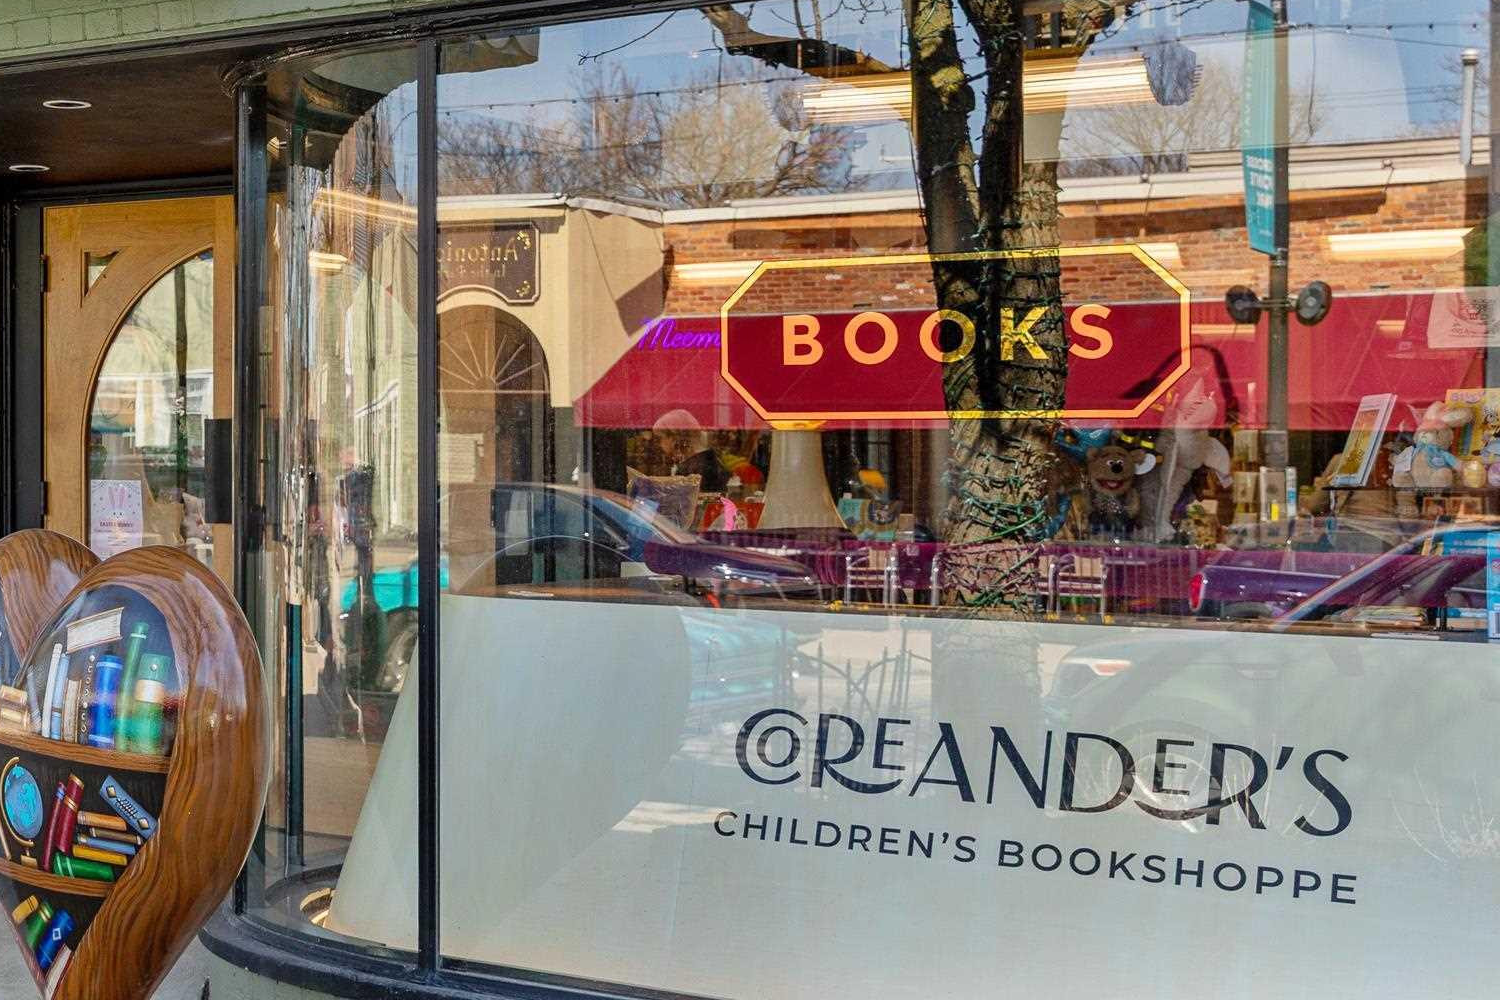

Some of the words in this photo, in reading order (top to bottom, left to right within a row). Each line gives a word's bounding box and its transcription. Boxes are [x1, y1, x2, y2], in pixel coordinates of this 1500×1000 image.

[782, 303, 1114, 367] BOOKS
[713, 810, 977, 864] CHILDREN'S
[997, 839, 1359, 905] BOOKSHOPPE
